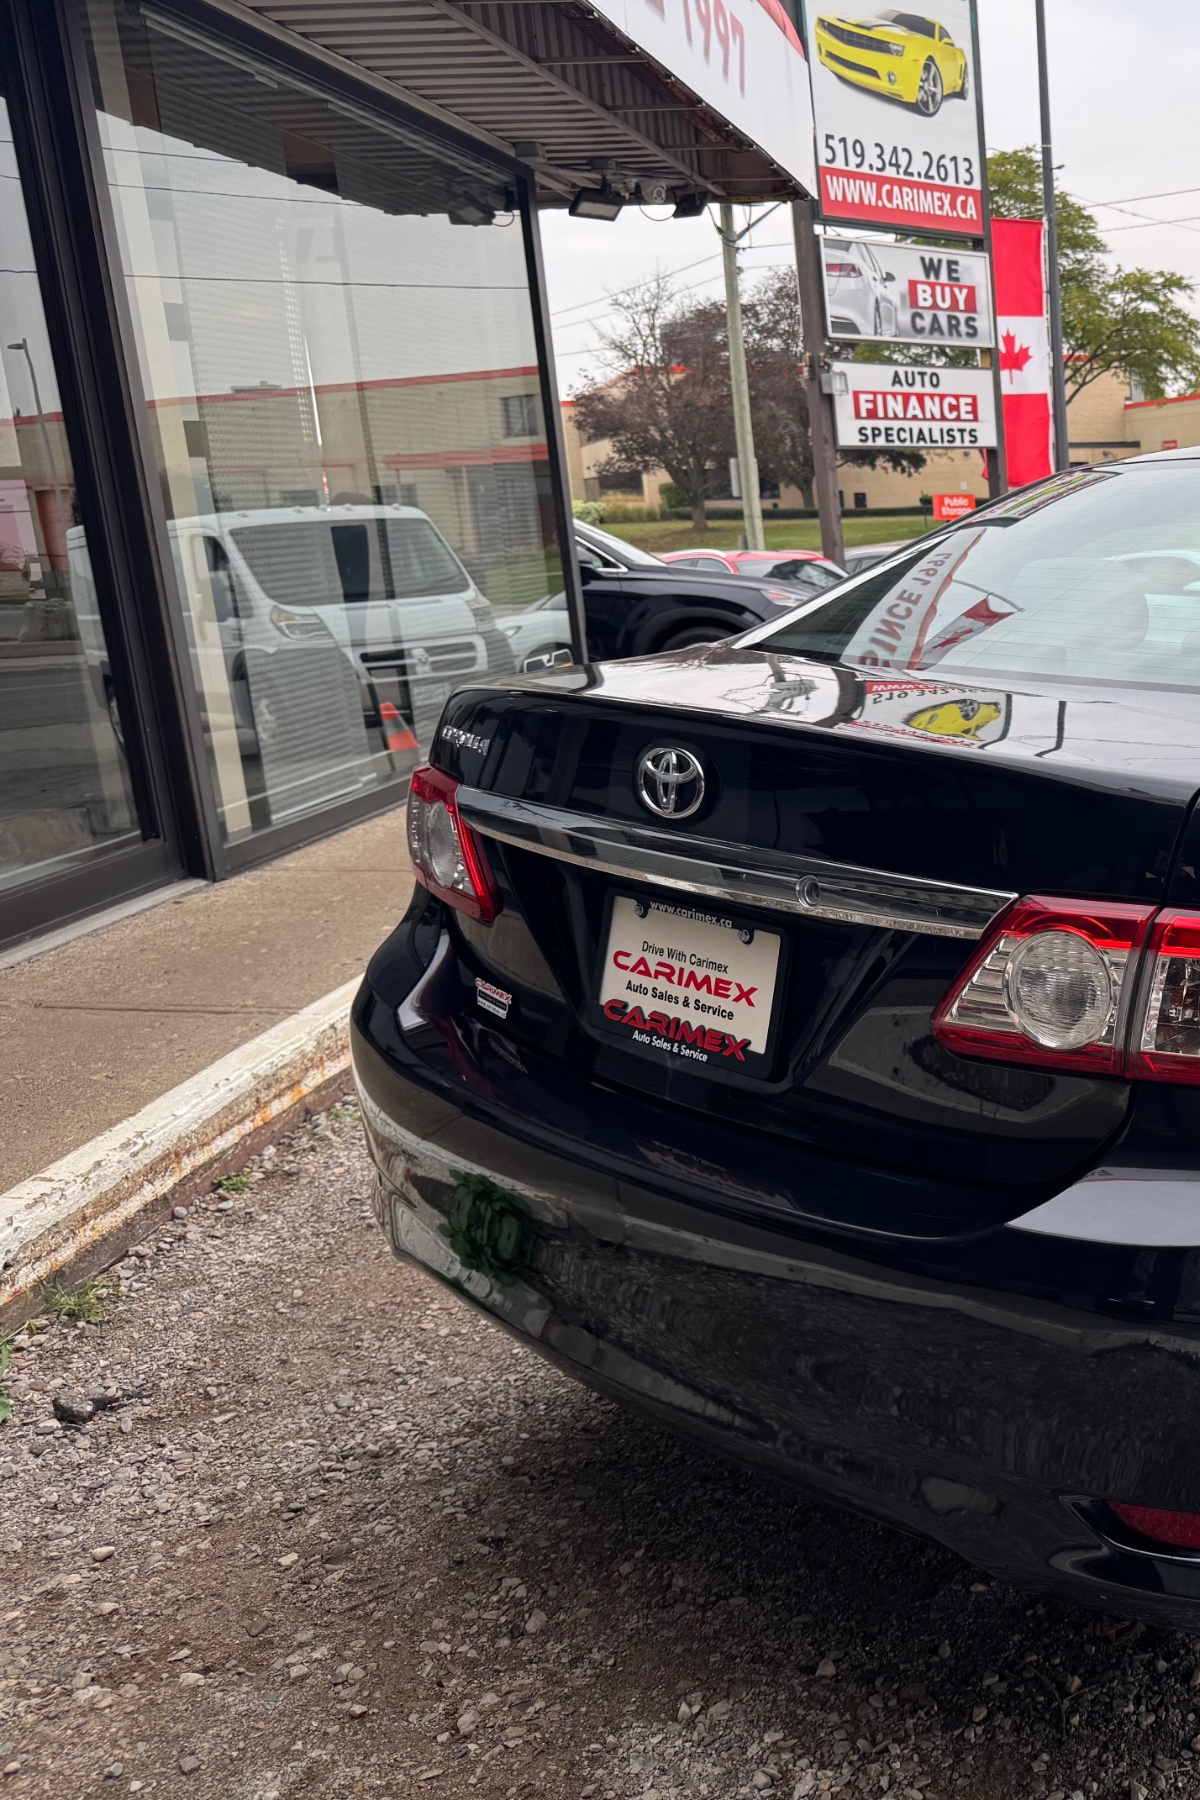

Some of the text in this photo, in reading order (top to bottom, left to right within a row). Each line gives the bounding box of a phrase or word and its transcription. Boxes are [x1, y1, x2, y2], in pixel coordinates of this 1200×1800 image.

[682, 0, 746, 97] 1997
[825, 133, 975, 186] 519.342.2613
[825, 174, 978, 220] WWW.CARIMEX.CA
[920, 256, 960, 282] WE
[916, 283, 969, 311] BUY
[911, 311, 978, 338] CARS
[891, 370, 940, 388] AUTO
[858, 393, 974, 420] FINANCE
[858, 426, 978, 444] SPECIALISTS
[650, 901, 733, 928] www.carimex.ca
[642, 941, 729, 974] Drive With Carimex
[475, 977, 512, 1004] CARIMEX
[613, 950, 758, 1006] CARIMEX
[625, 980, 735, 1021] Auto Sales & Service
[603, 998, 752, 1062] CARIMEX
[632, 1029, 708, 1062] Auto Sales & Service
